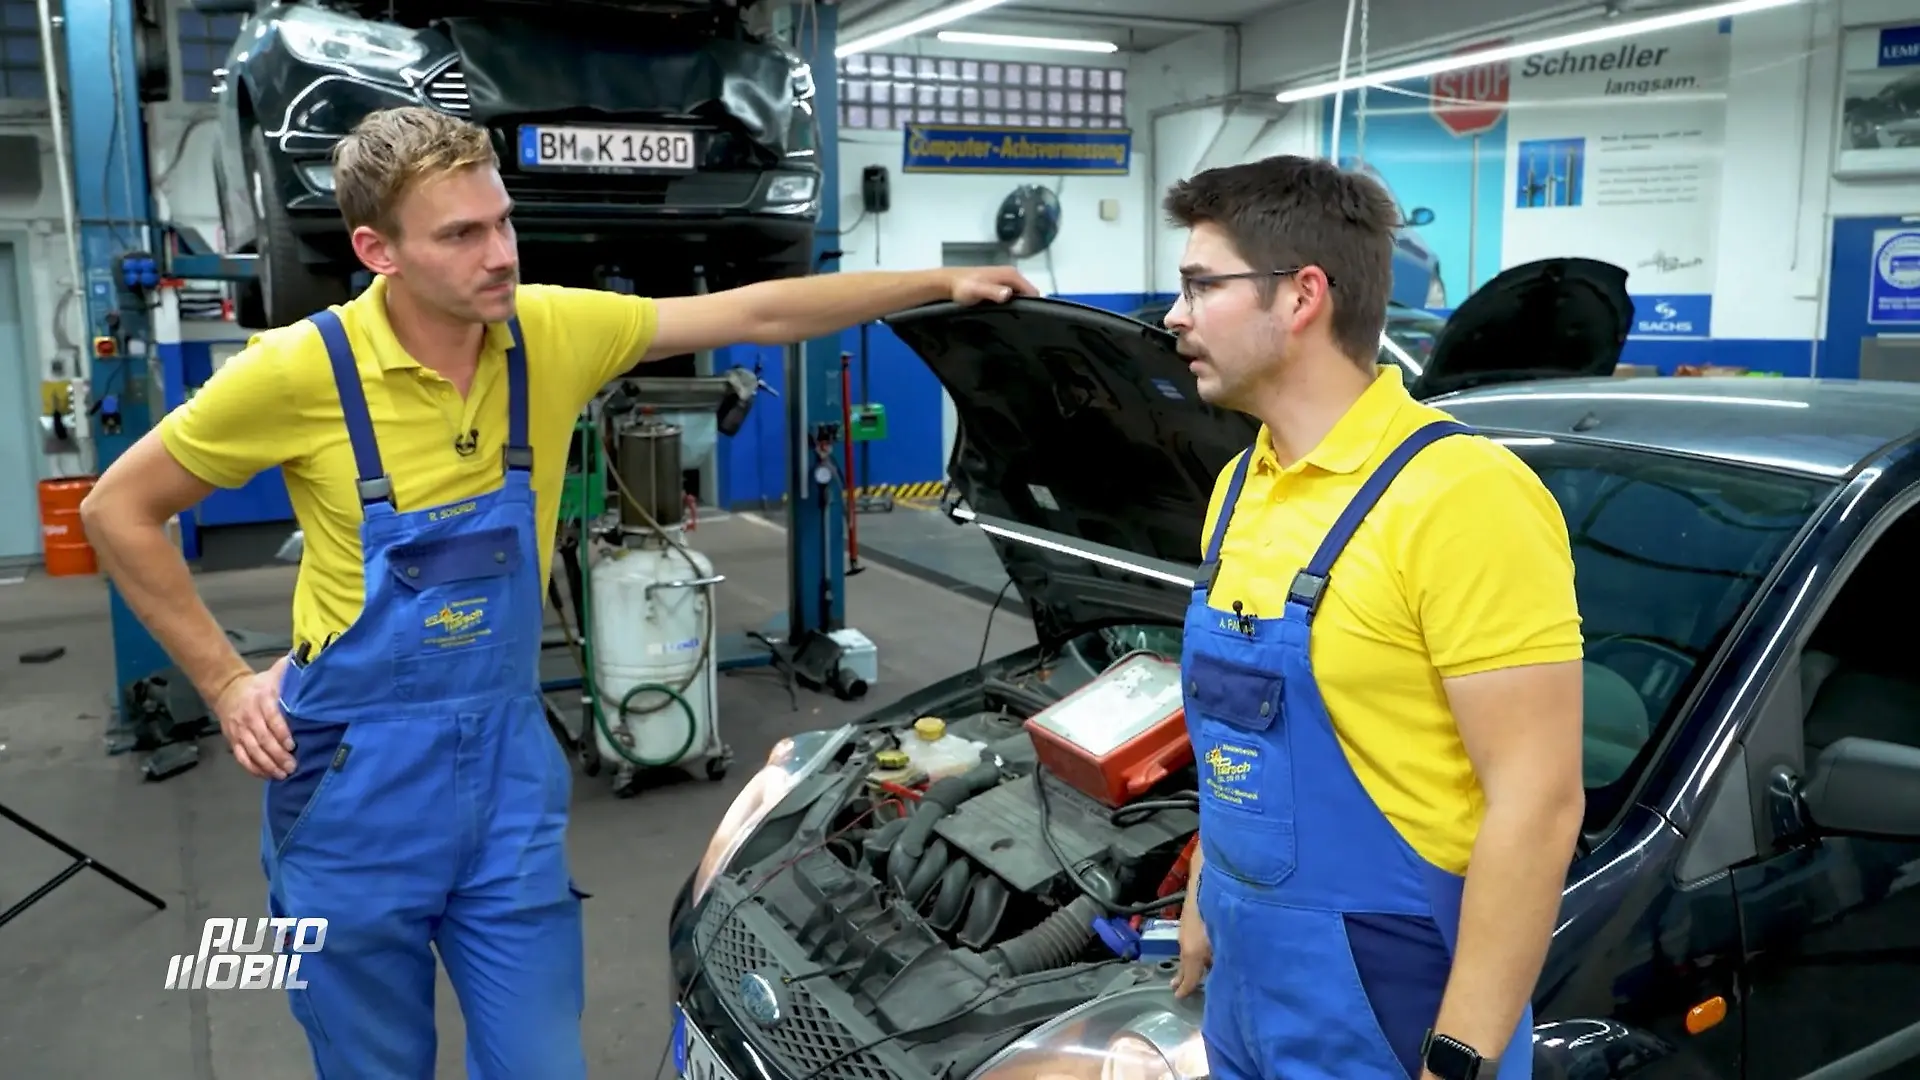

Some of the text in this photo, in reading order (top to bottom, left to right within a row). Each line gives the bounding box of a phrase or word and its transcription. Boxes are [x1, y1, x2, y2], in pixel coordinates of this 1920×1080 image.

[1521, 44, 1669, 78] Schneller
[1436, 62, 1509, 105] STOP
[1604, 75, 1701, 96] langsam.
[540, 132, 577, 160] BM
[598, 134, 614, 161] K
[1638, 320, 1693, 332] SACHS
